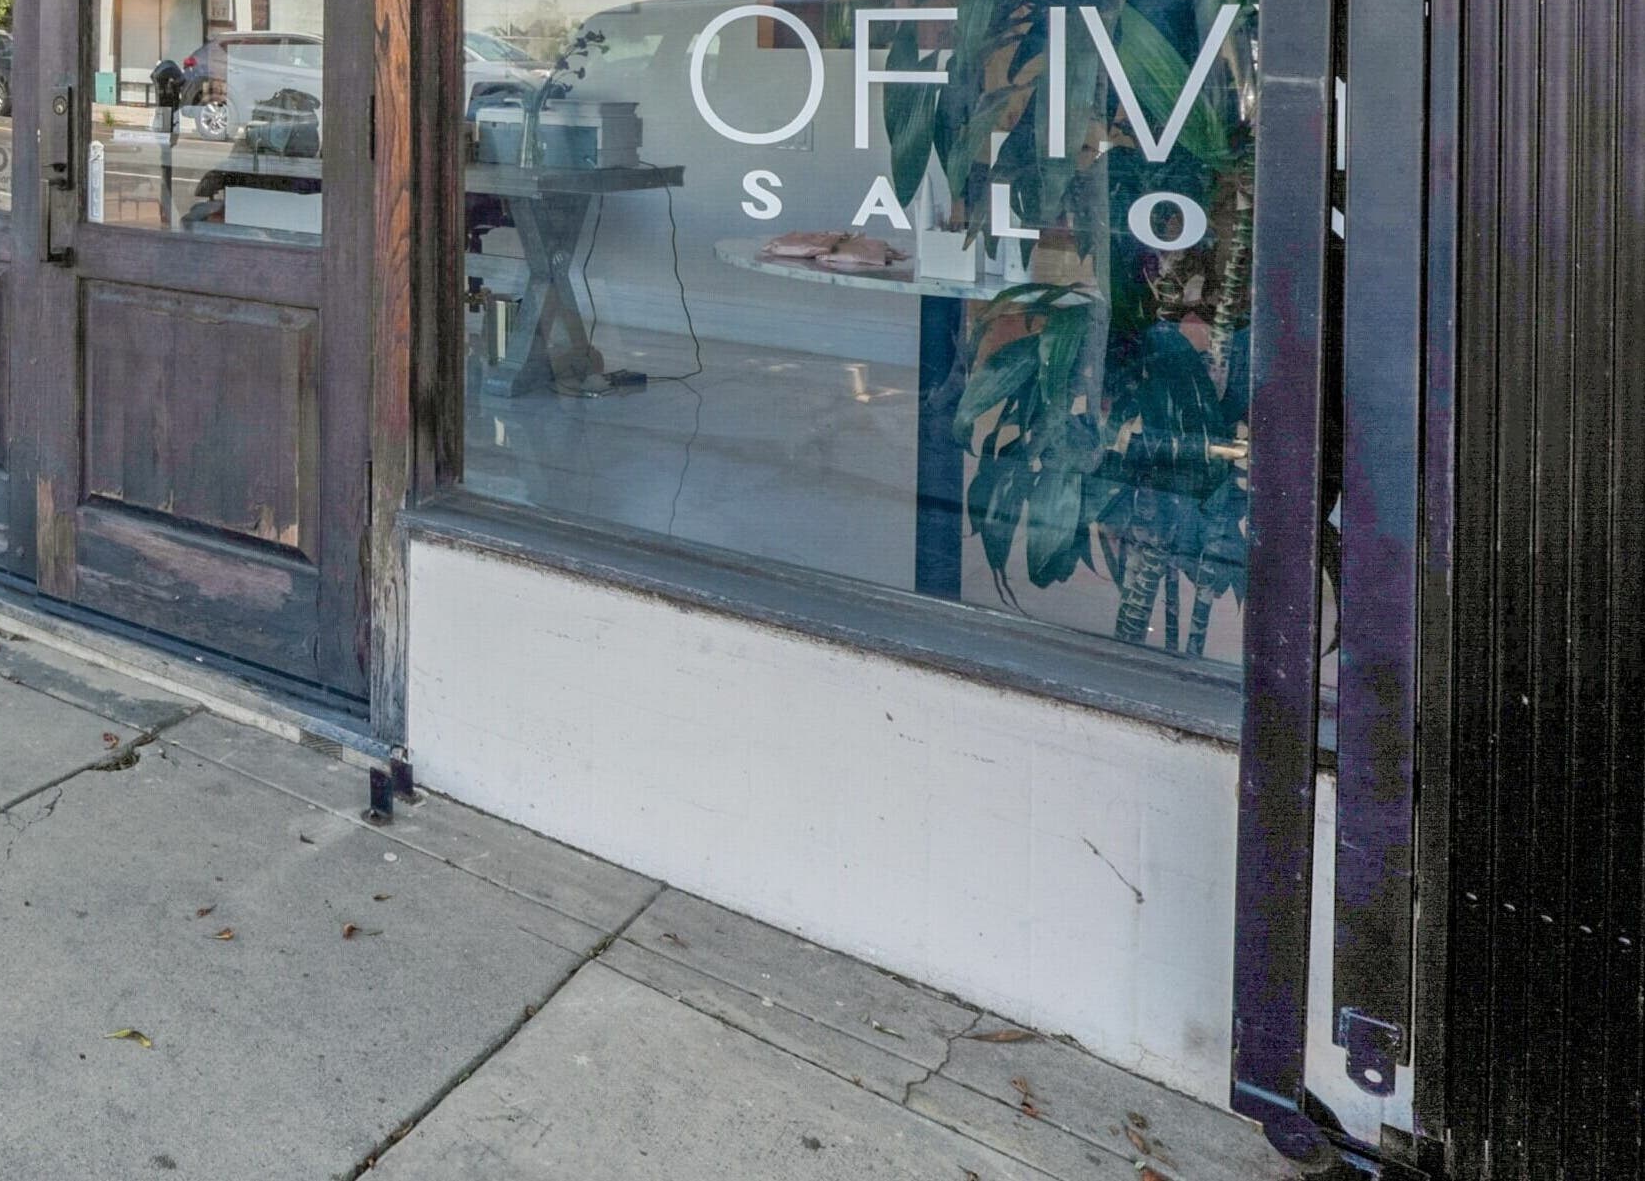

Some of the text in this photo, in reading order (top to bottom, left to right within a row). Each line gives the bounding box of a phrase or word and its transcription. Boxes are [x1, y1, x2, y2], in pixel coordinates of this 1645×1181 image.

[689, 3, 1262, 162] OF IV
[740, 169, 1210, 252] SALO
